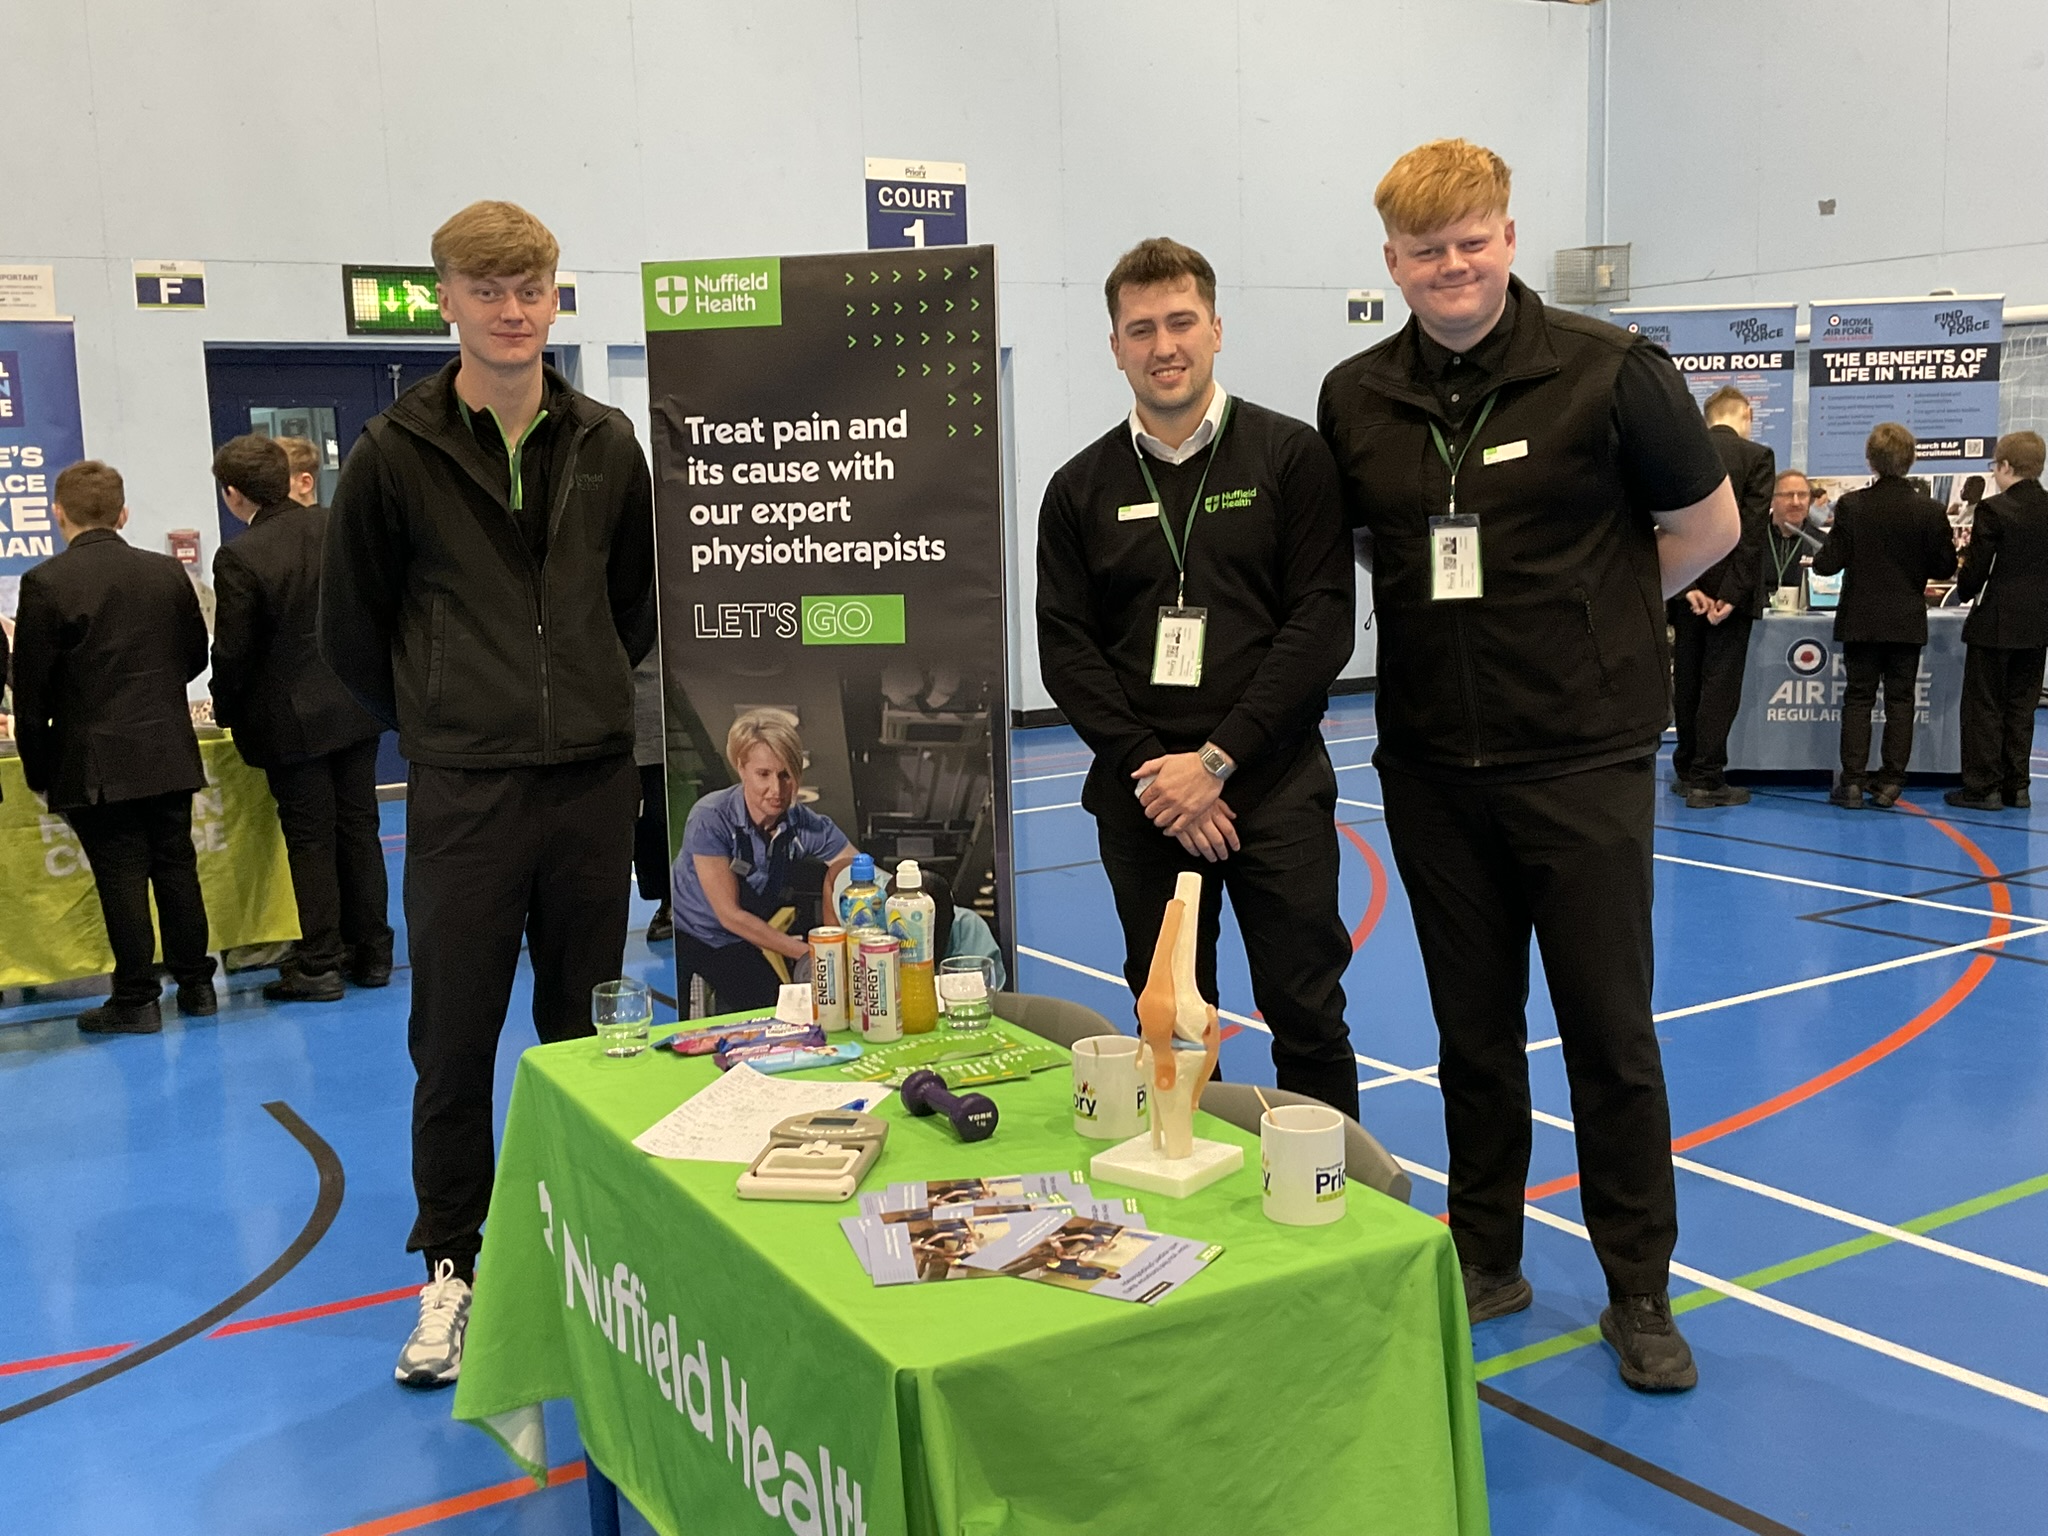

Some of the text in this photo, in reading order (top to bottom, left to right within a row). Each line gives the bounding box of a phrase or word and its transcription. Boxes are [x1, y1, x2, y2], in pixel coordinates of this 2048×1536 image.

[878, 186, 954, 209] COURT
[903, 218, 924, 249] 1
[159, 277, 183, 304] F
[694, 272, 767, 293] Nuffield
[696, 293, 756, 313] Health
[1360, 301, 1371, 321] J
[1729, 317, 1757, 331] FIND
[1841, 317, 1873, 326] ROYAL
[1935, 309, 1963, 323] FIND
[1940, 315, 1973, 330] YOUR
[1641, 325, 1669, 334] ROYAL
[1735, 323, 1767, 338] YOUR
[1743, 327, 1784, 344] FORCE
[1823, 327, 1873, 336] AIR FORCE
[1949, 319, 1990, 337] FORCE
[1671, 353, 1783, 371] YOUR ROLE
[1823, 348, 1988, 368] THE BENEFITS OF
[1829, 364, 1980, 383] LIFE IN THE RAF
[685, 409, 907, 450] Treat pain and
[1914, 449, 1961, 457] ecruitment
[687, 451, 894, 485] its cause with
[1221, 498, 1251, 509] Health
[1222, 487, 1257, 500] Nuffield
[690, 497, 851, 530] our expert
[692, 532, 946, 573] physiotherapists
[694, 602, 873, 638] LET'S GO
[1768, 680, 1825, 705] AIR
[1766, 708, 1841, 722] REGULAR
[816, 957, 828, 1005] ENERGY
[853, 957, 862, 1006] ENERGY
[868, 967, 879, 1016] ENERGY
[1073, 1093, 1096, 1116] ory
[968, 1111, 992, 1121] YORK
[563, 1218, 713, 1443] Nuffield
